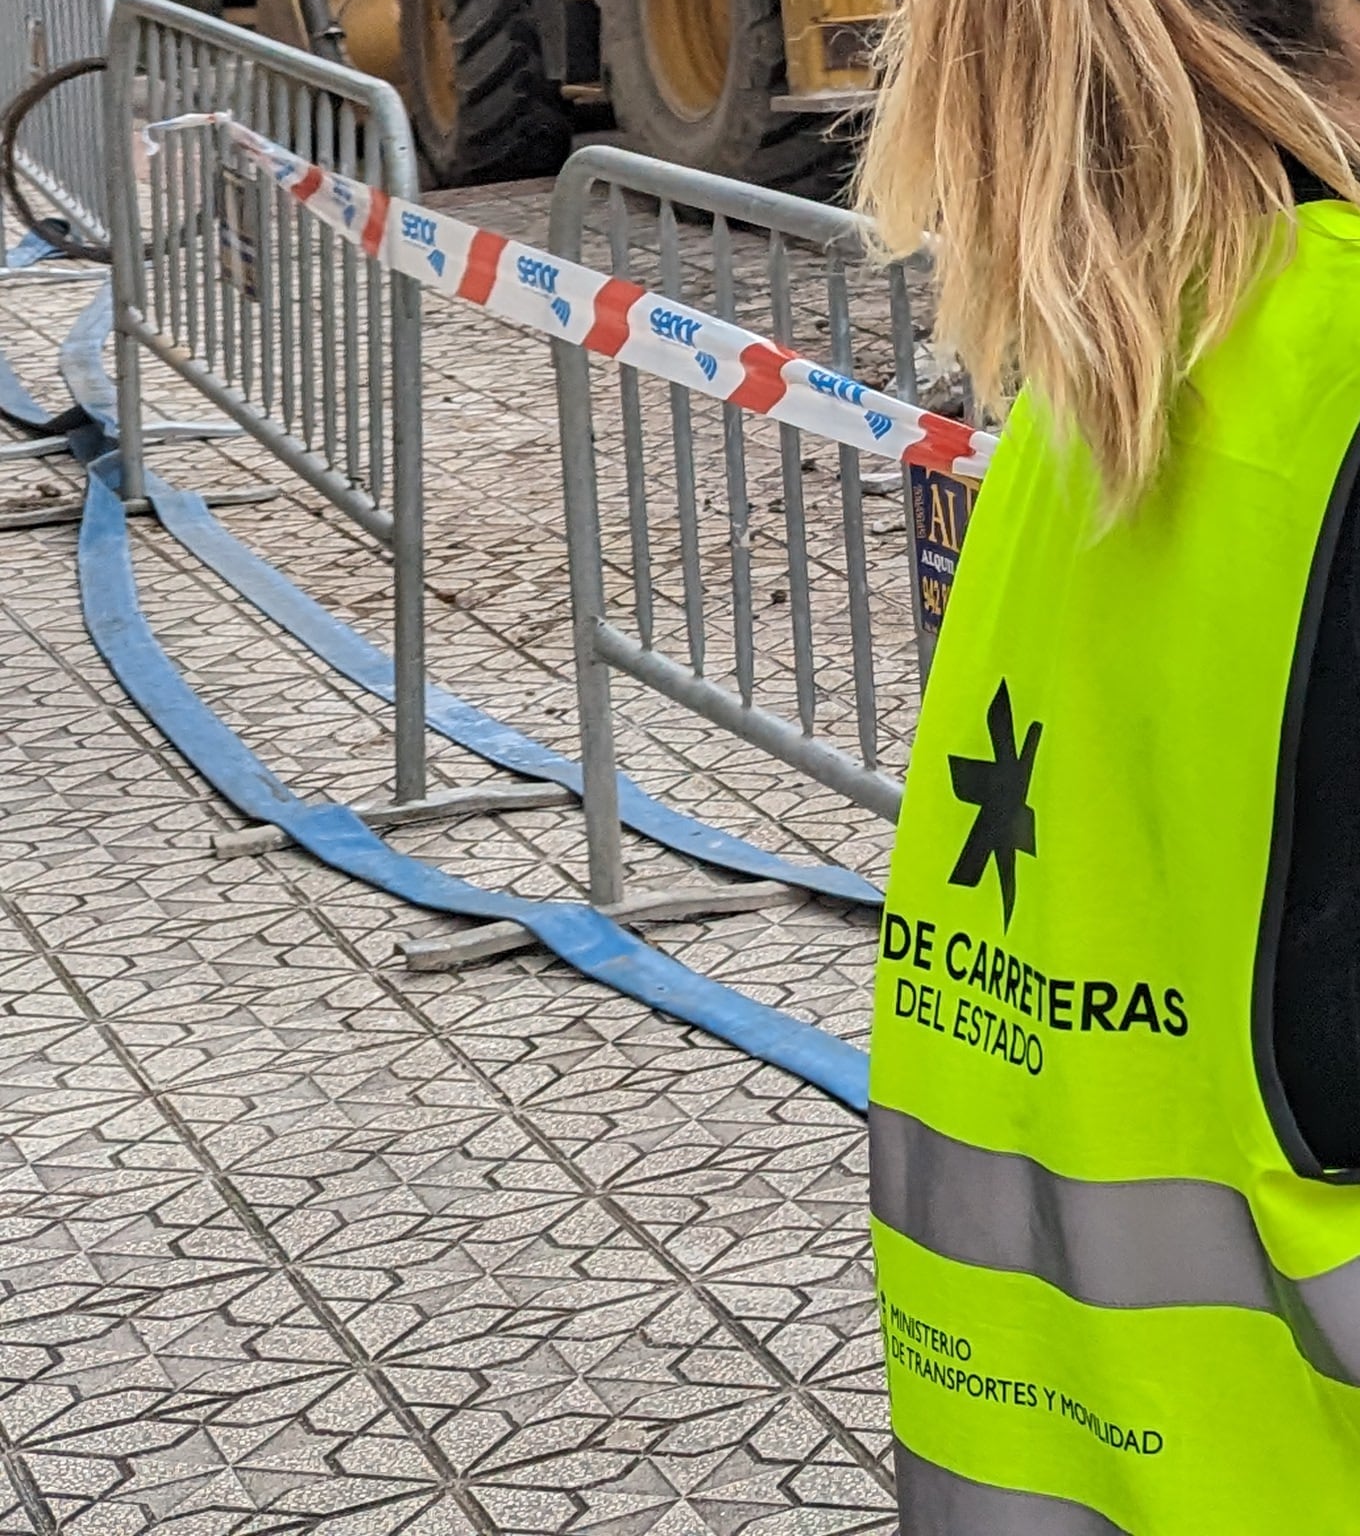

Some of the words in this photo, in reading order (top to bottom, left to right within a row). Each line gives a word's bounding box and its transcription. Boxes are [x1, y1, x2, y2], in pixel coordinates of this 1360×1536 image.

[883, 912, 936, 972] DE
[945, 932, 1189, 1038] CARRETERAS
[895, 977, 946, 1033] DEL
[953, 998, 1044, 1076] ESTADO
[891, 1303, 972, 1362] MINISTERIO
[892, 1335, 906, 1366] DE
[906, 1346, 1038, 1408] TRANSPORTES
[1043, 1387, 1056, 1412] Y
[1061, 1393, 1164, 1455] MOVILIDAD
